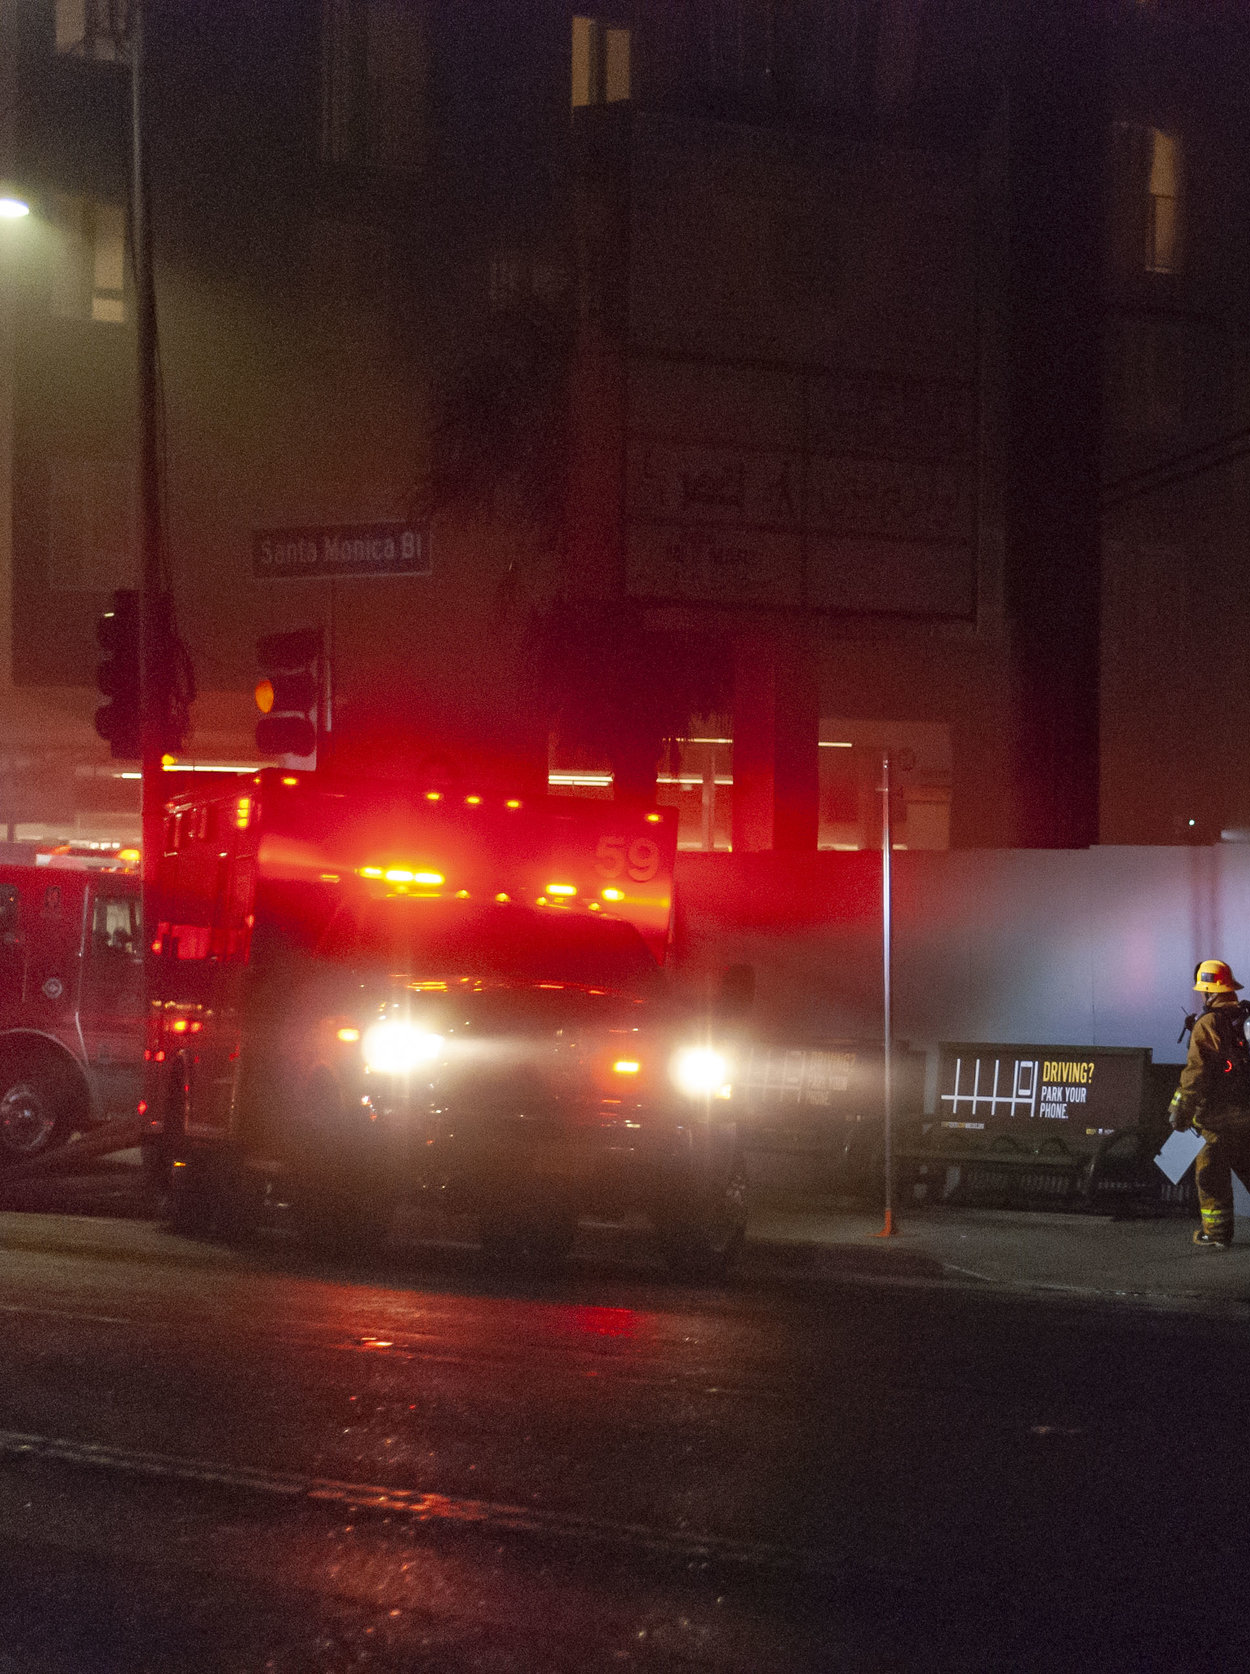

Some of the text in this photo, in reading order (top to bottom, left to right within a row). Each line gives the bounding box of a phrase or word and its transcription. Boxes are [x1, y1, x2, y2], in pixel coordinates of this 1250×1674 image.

[260, 537, 318, 565] Santa
[323, 534, 396, 563] Monica
[596, 835, 661, 883] 59
[1042, 1061, 1095, 1084] DRIVING?
[1041, 1086, 1087, 1103] PARK YOUR
[1039, 1103, 1069, 1119] PHONE.
